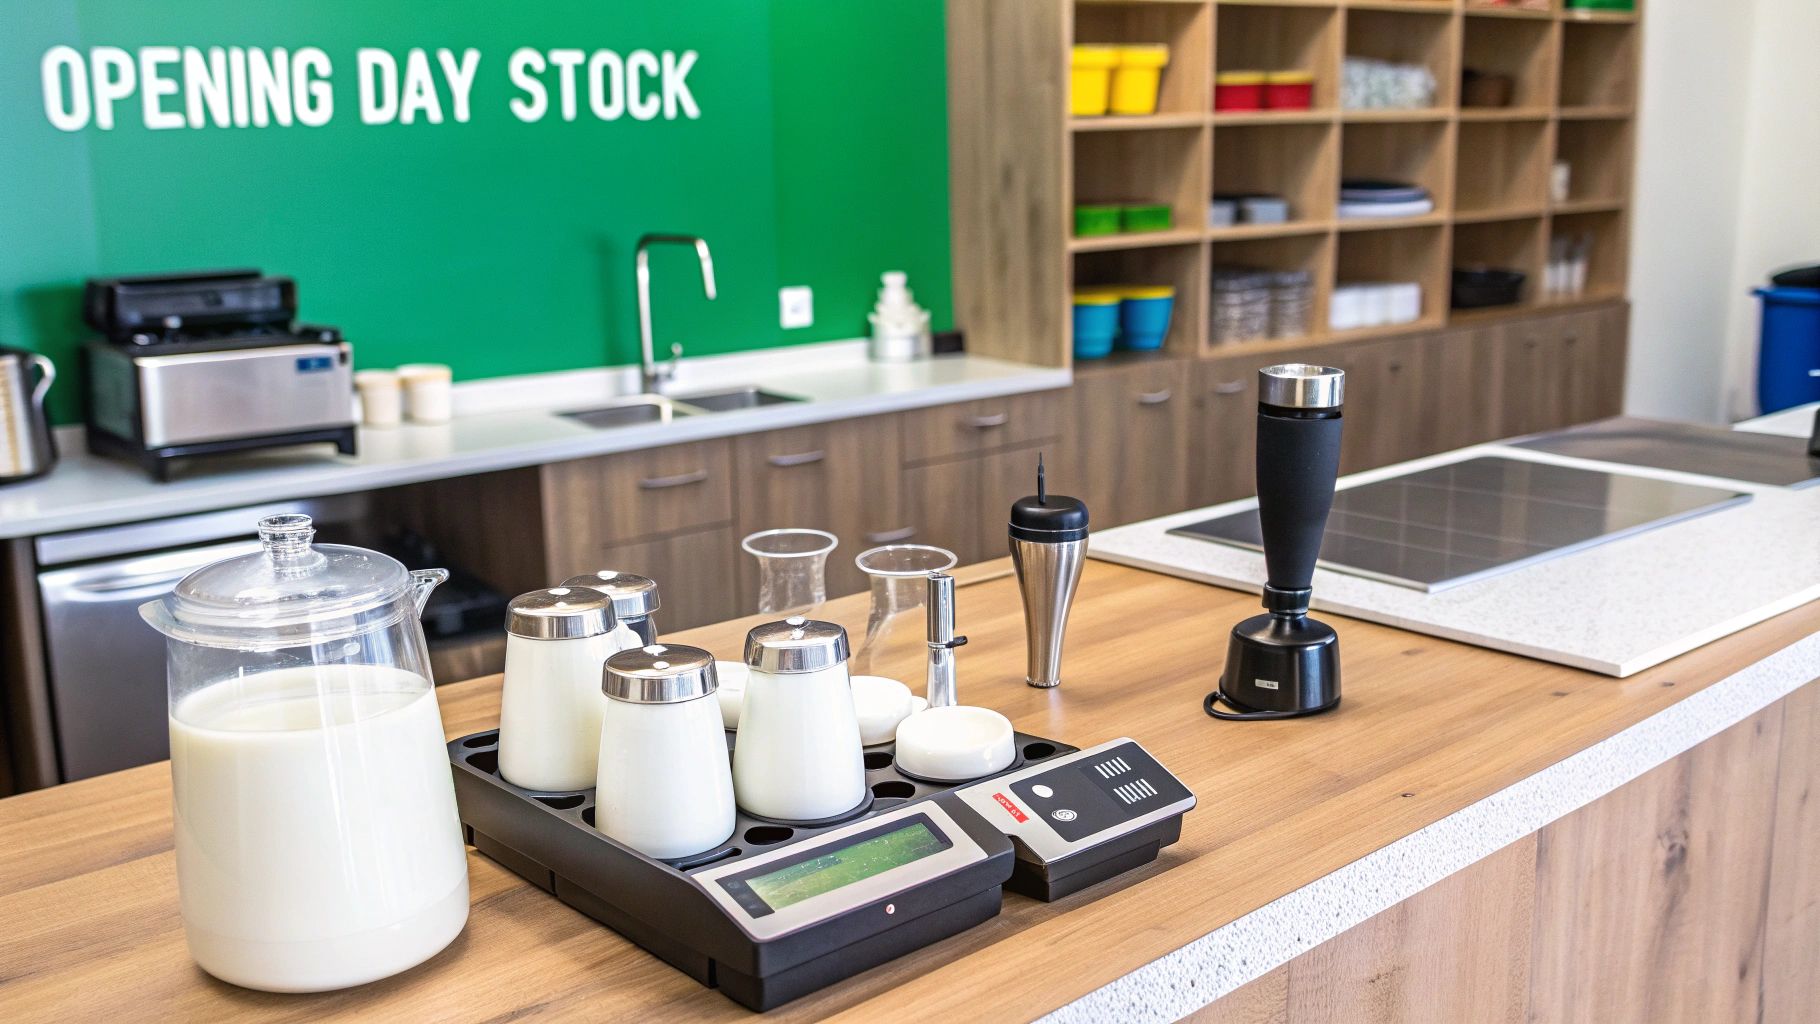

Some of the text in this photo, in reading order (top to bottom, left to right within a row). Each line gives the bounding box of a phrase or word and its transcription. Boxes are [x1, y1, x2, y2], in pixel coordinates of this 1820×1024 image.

[41, 45, 701, 131] OPENING DAY STOCK
